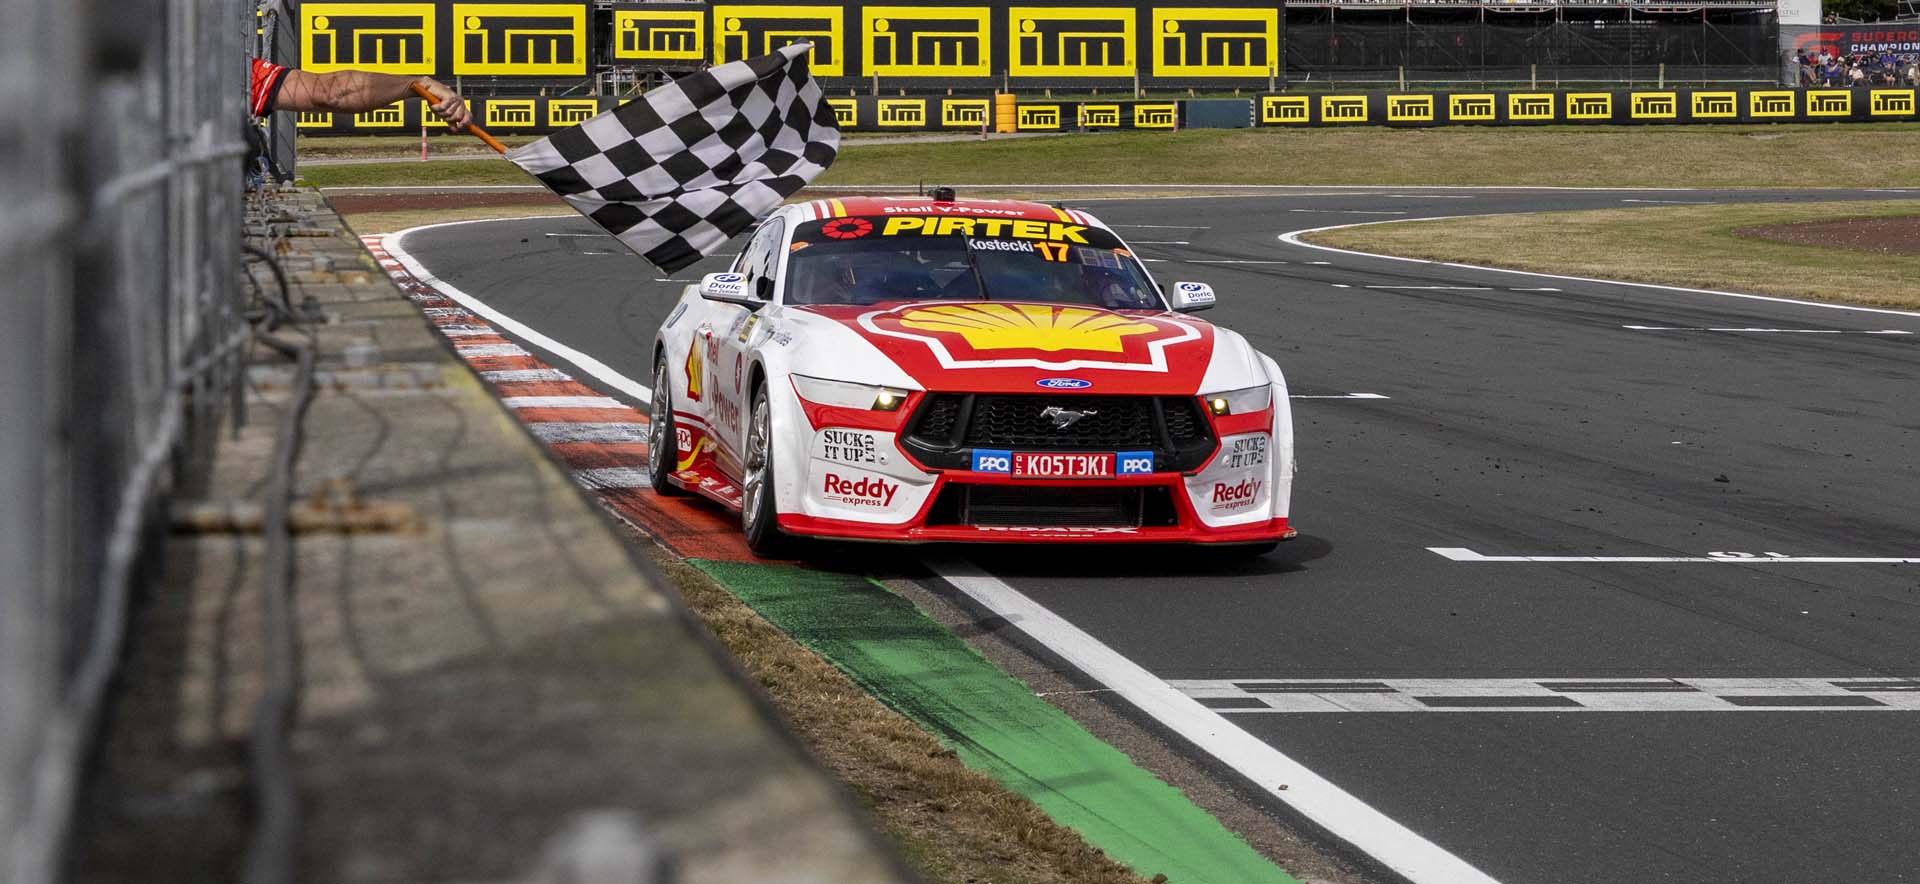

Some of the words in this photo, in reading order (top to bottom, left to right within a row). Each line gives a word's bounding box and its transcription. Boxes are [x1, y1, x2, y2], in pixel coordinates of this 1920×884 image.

[312, 15, 423, 64] itm
[464, 15, 574, 64] itm
[623, 18, 695, 51] itm
[872, 18, 979, 66] itm
[1019, 19, 1124, 66] itm
[1163, 19, 1267, 66] itm
[1267, 99, 1304, 118] itm
[1326, 99, 1364, 118] itm
[1391, 98, 1429, 116] itm
[1453, 97, 1490, 116] itm
[1512, 97, 1550, 115] itm
[1570, 97, 1608, 115] itm
[1635, 96, 1672, 113] itm
[1695, 95, 1733, 113] itm
[1753, 95, 1791, 112] itm
[1810, 94, 1848, 112] itm
[1874, 93, 1911, 111] itm
[490, 104, 530, 122] itm
[881, 103, 921, 122] itm
[1022, 109, 1055, 124] itm
[939, 206, 1025, 216] V-Power
[882, 217, 1089, 244] PIRTEK
[1034, 241, 1069, 262] 17
[709, 282, 742, 290] Doric
[824, 430, 864, 447] SUCK
[1233, 437, 1260, 453] SUCK
[824, 445, 840, 459] IT
[843, 447, 864, 462] UP
[864, 434, 876, 463] LTD
[979, 456, 1009, 471] PPQ
[1123, 458, 1152, 473] PPQ
[1231, 454, 1243, 468] IT
[1244, 452, 1257, 466] UP
[824, 473, 899, 507] Reddy
[1213, 477, 1261, 504] Reddy
[842, 496, 882, 506] express
[1225, 500, 1251, 510] express
